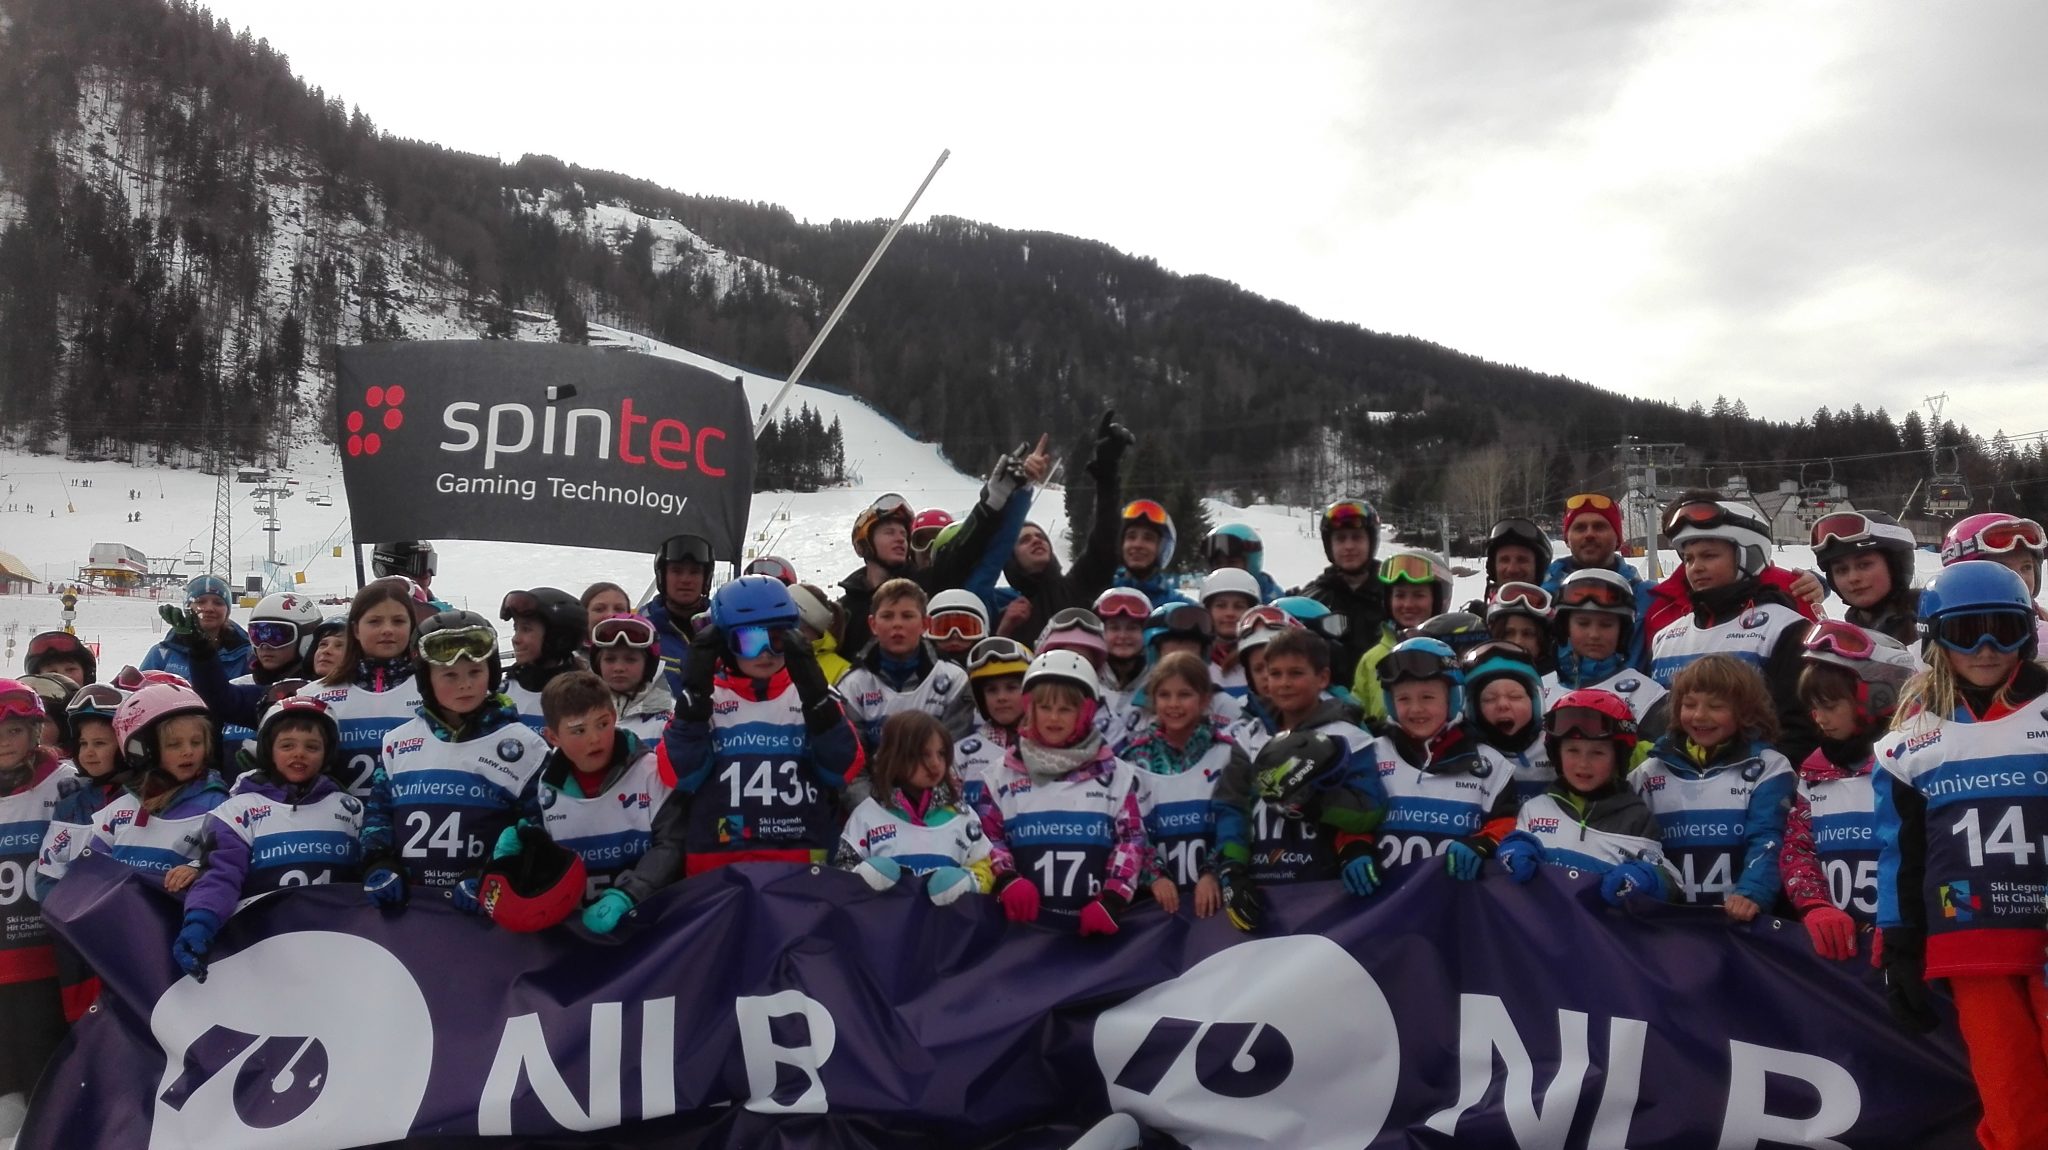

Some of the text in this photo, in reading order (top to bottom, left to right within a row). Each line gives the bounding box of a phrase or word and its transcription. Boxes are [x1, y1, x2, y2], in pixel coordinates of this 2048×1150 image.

[440, 385, 727, 477] spintec
[436, 473, 688, 516] Gaming Technology
[1725, 632, 1746, 640] BMW
[321, 689, 348, 698] INTER
[399, 738, 424, 748] INTER
[723, 732, 789, 748] universe
[1907, 728, 1942, 747] INTER
[398, 745, 422, 755] SPORT
[1909, 735, 1942, 754] SPORT
[478, 756, 499, 769] BMW
[1378, 768, 1395, 777] ORT
[403, 780, 466, 796] universe
[1455, 781, 1478, 789] BMW
[1646, 783, 1666, 792] ORT
[1929, 770, 2048, 797] universe o
[44, 800, 57, 808] BM
[115, 809, 135, 819] TER
[1159, 811, 1201, 828] verse
[1386, 806, 1449, 825] universe
[1454, 812, 1471, 827] of
[772, 817, 802, 826] Legends
[1530, 817, 1560, 827] INTER
[759, 826, 771, 834] Hit
[868, 824, 897, 836] INTER
[1018, 821, 1083, 838] universe
[1086, 820, 1102, 836] of
[1531, 825, 1559, 834] SPORT
[1660, 822, 1744, 841] universe o
[0, 831, 40, 847] verse
[870, 832, 897, 845] SPORT
[1952, 805, 2048, 867] 14
[261, 841, 352, 860] universe of
[578, 845, 621, 862] verse
[624, 838, 638, 854] of
[424, 870, 436, 878] Ski
[1034, 850, 1101, 897] 17b
[424, 878, 436, 886] Hit
[1822, 858, 1879, 914] 05
[1991, 883, 2009, 892] Ski
[1992, 893, 2047, 904] Hit Challe
[1993, 905, 2047, 916] by Jure Ko
